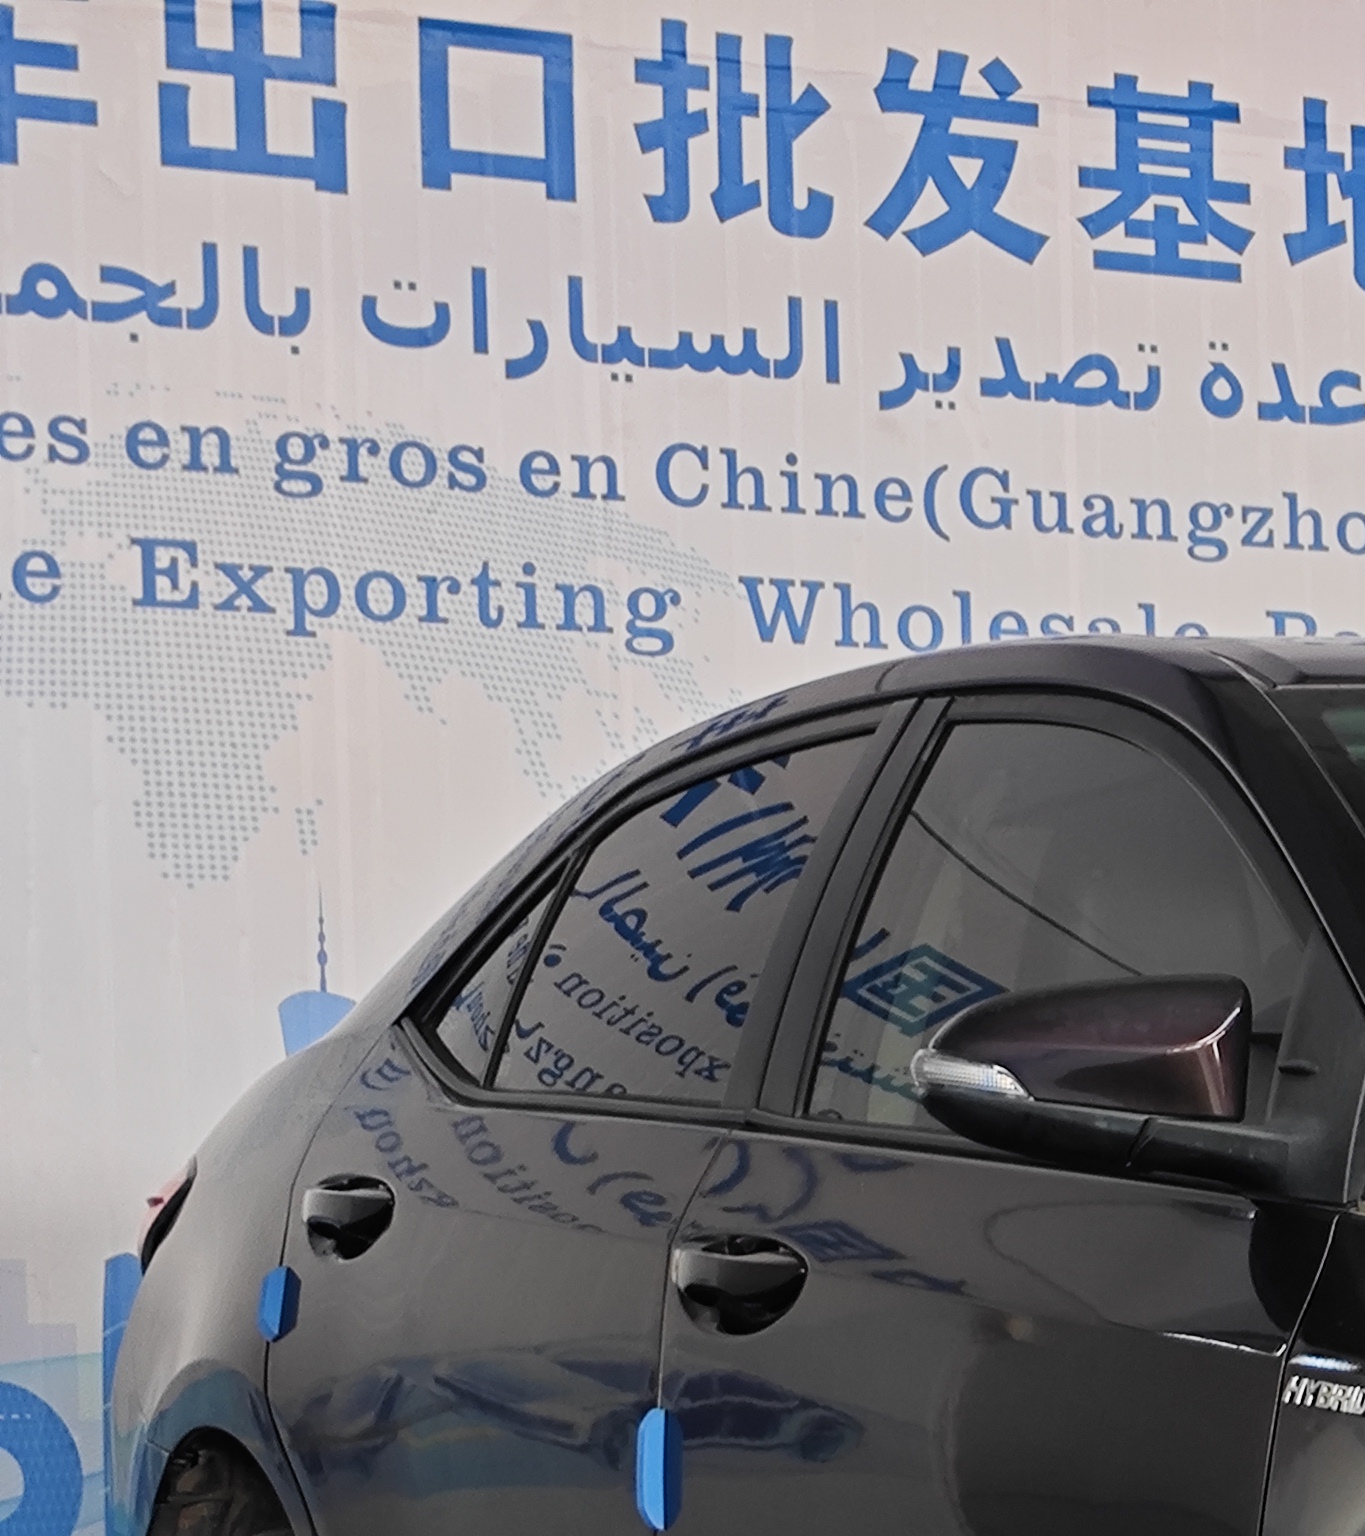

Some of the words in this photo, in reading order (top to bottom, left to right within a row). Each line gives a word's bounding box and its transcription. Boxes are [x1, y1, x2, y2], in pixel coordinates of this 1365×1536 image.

[361, 266, 840, 384] السيارات
[878, 337, 1162, 411] تصدير
[124, 420, 239, 475] en
[274, 430, 489, 499] gros
[518, 450, 625, 502] en
[130, 536, 682, 657] Exporting
